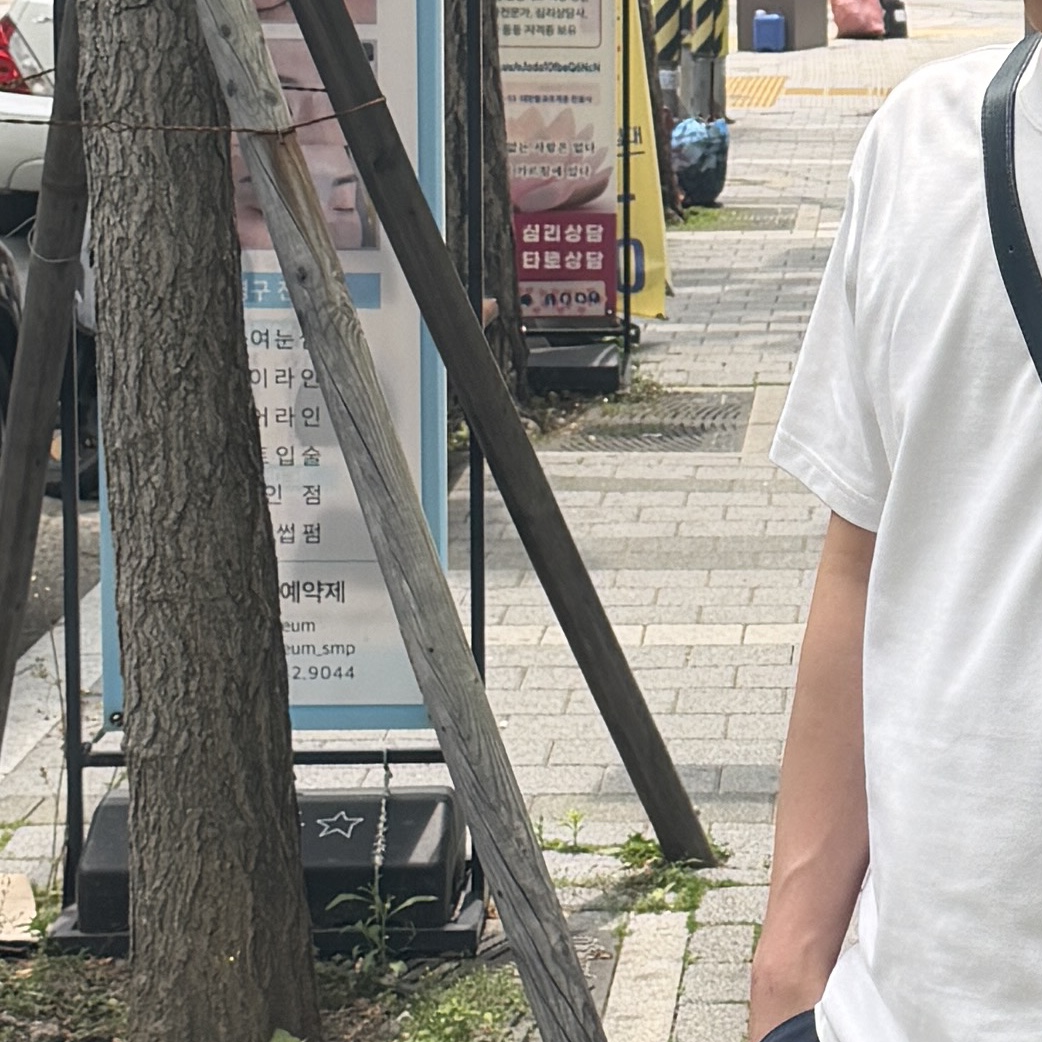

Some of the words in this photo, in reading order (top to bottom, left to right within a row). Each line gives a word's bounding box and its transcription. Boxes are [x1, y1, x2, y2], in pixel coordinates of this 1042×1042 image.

[523, 224, 603, 242] 심리상담
[523, 251, 603, 270] 타로상담
[280, 580, 345, 604] 예약제
